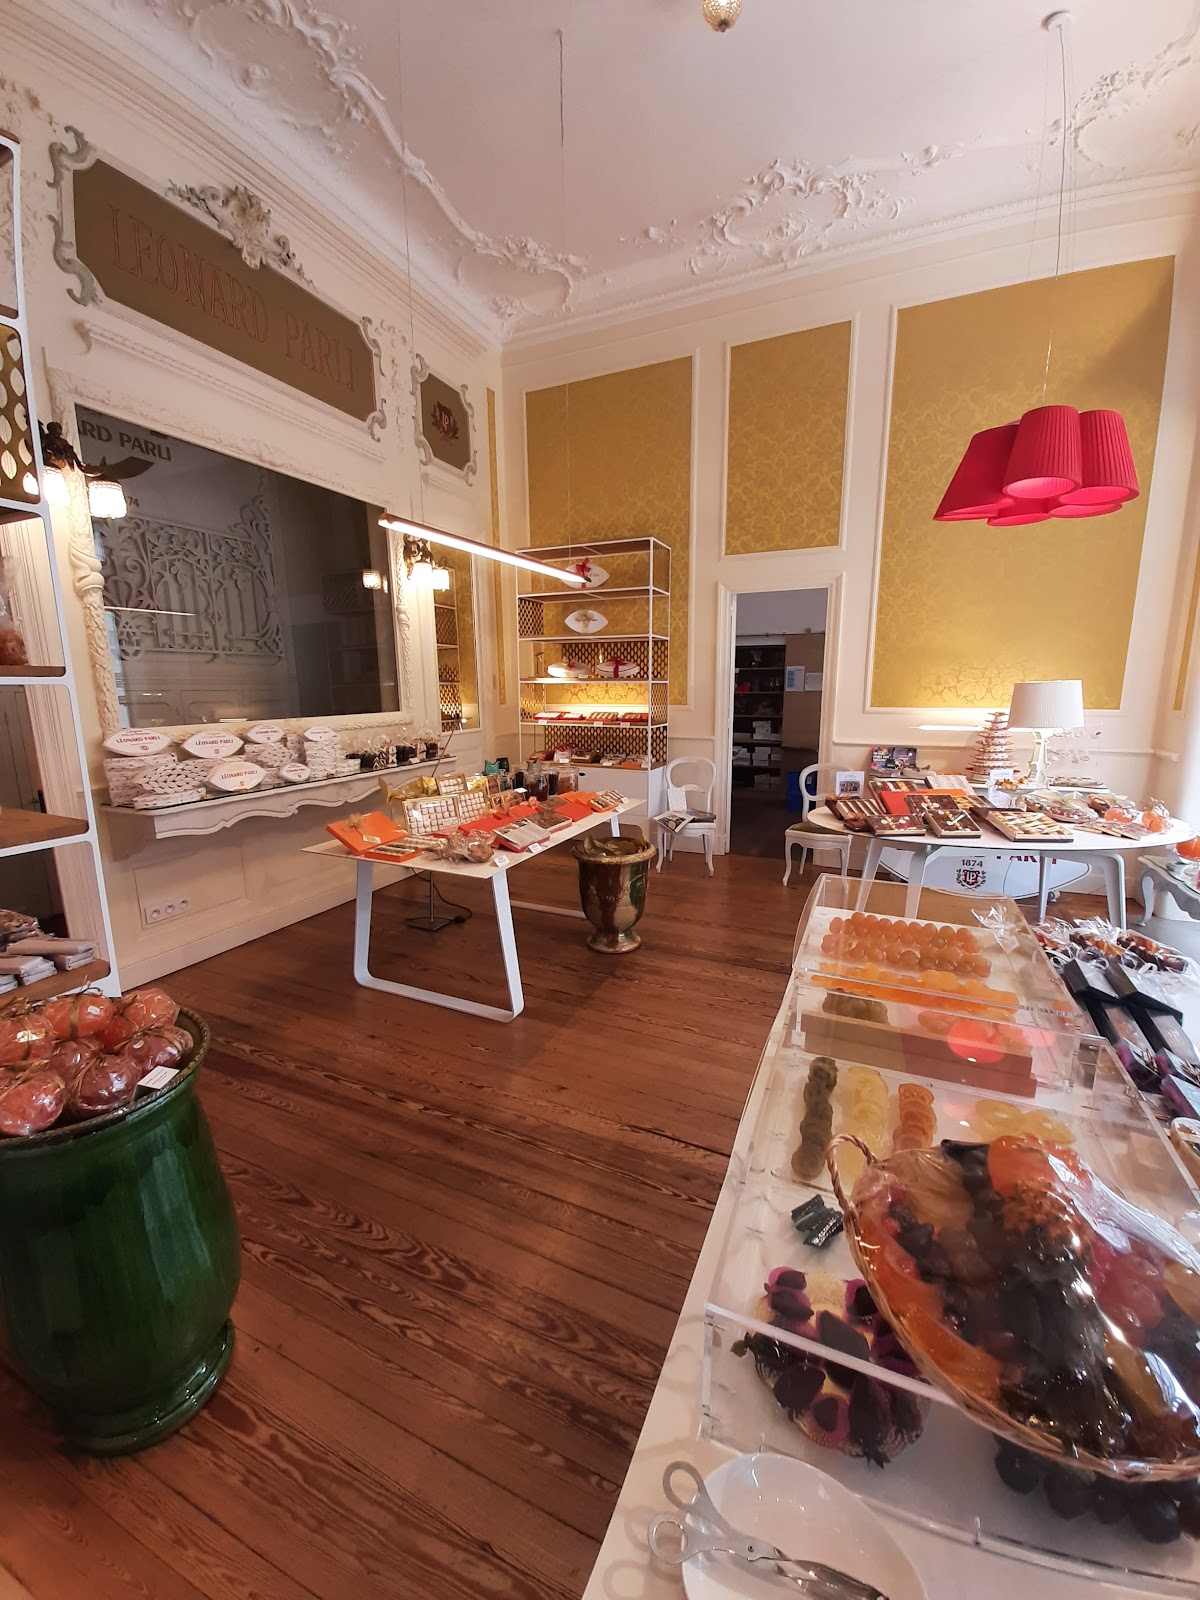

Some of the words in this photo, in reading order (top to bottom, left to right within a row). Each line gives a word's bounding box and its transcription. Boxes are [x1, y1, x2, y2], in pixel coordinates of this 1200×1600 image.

[281, 305, 356, 392] PARLI
[119, 432, 172, 462] PARLI
[961, 859, 983, 868] 1874
